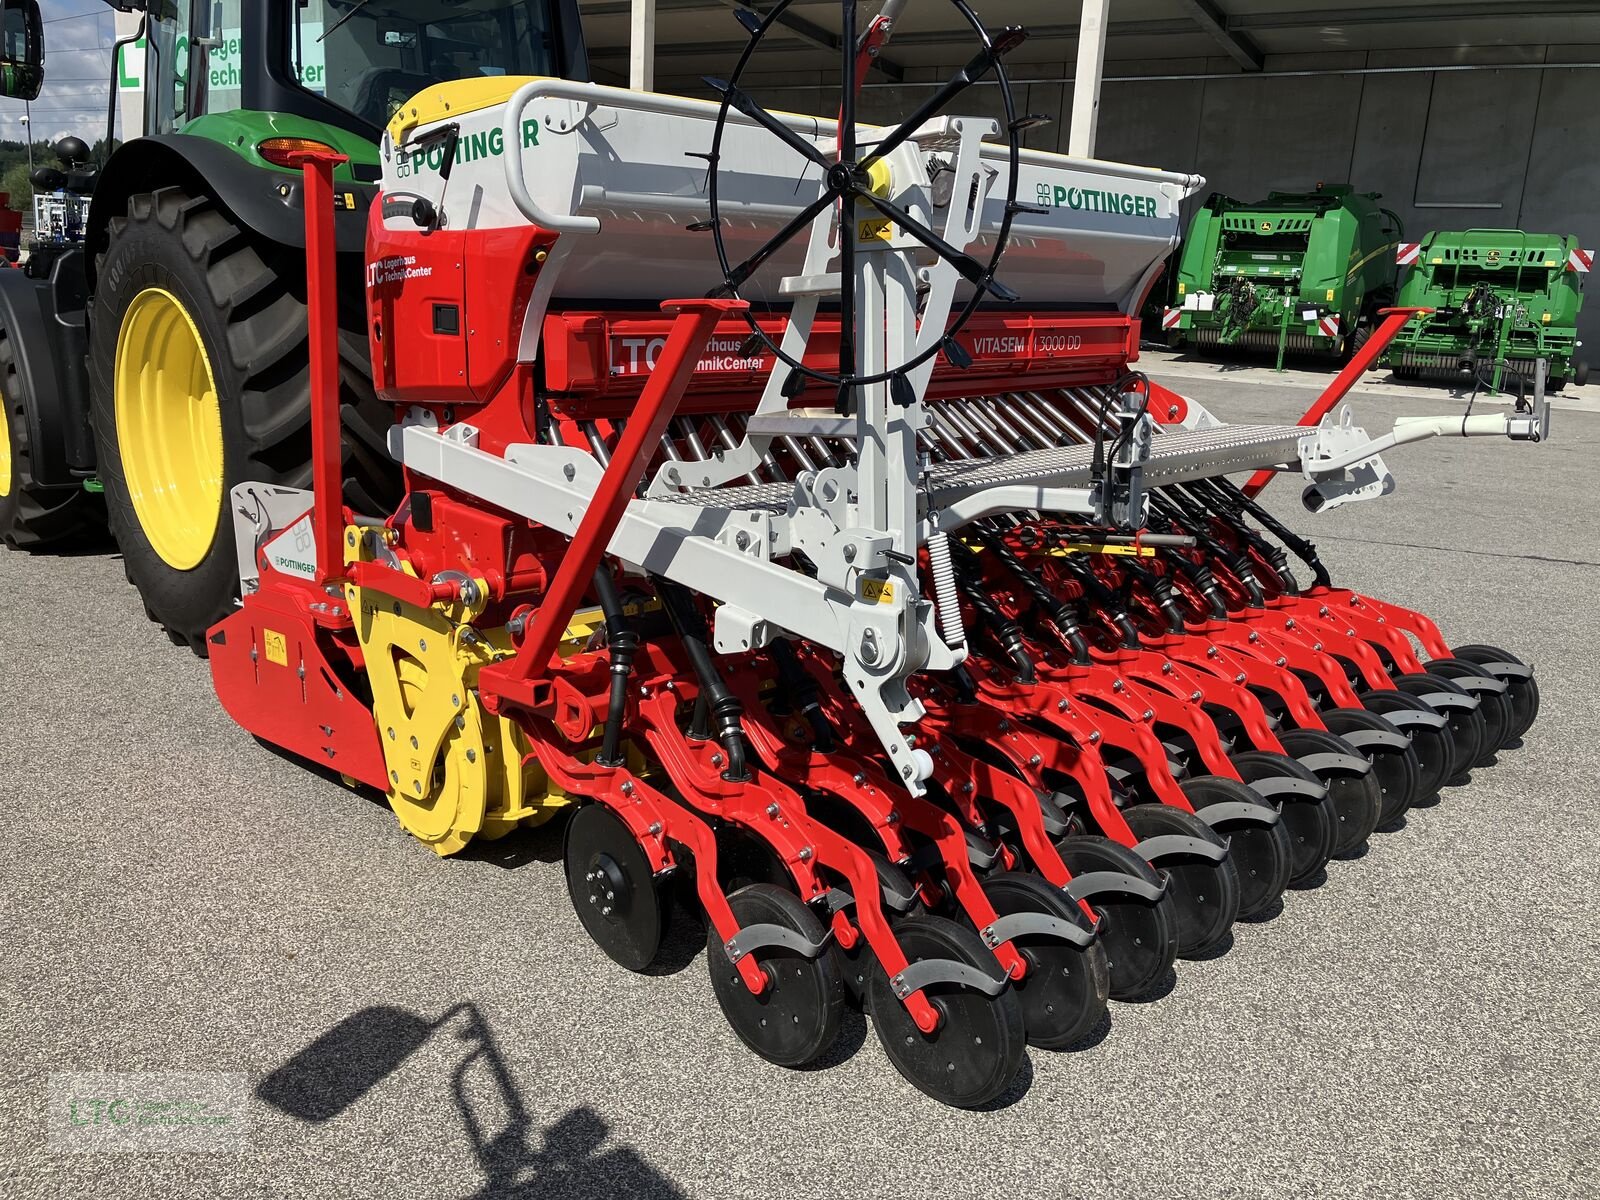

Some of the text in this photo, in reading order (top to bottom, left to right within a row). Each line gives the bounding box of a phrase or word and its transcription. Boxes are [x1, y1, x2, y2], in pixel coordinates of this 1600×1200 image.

[1053, 185, 1157, 218] PÖTTINGER
[384, 255, 416, 270] Lagerhaus
[366, 261, 384, 288] LTC
[973, 336, 1025, 354] VITASEM
[1039, 335, 1066, 352] 3000
